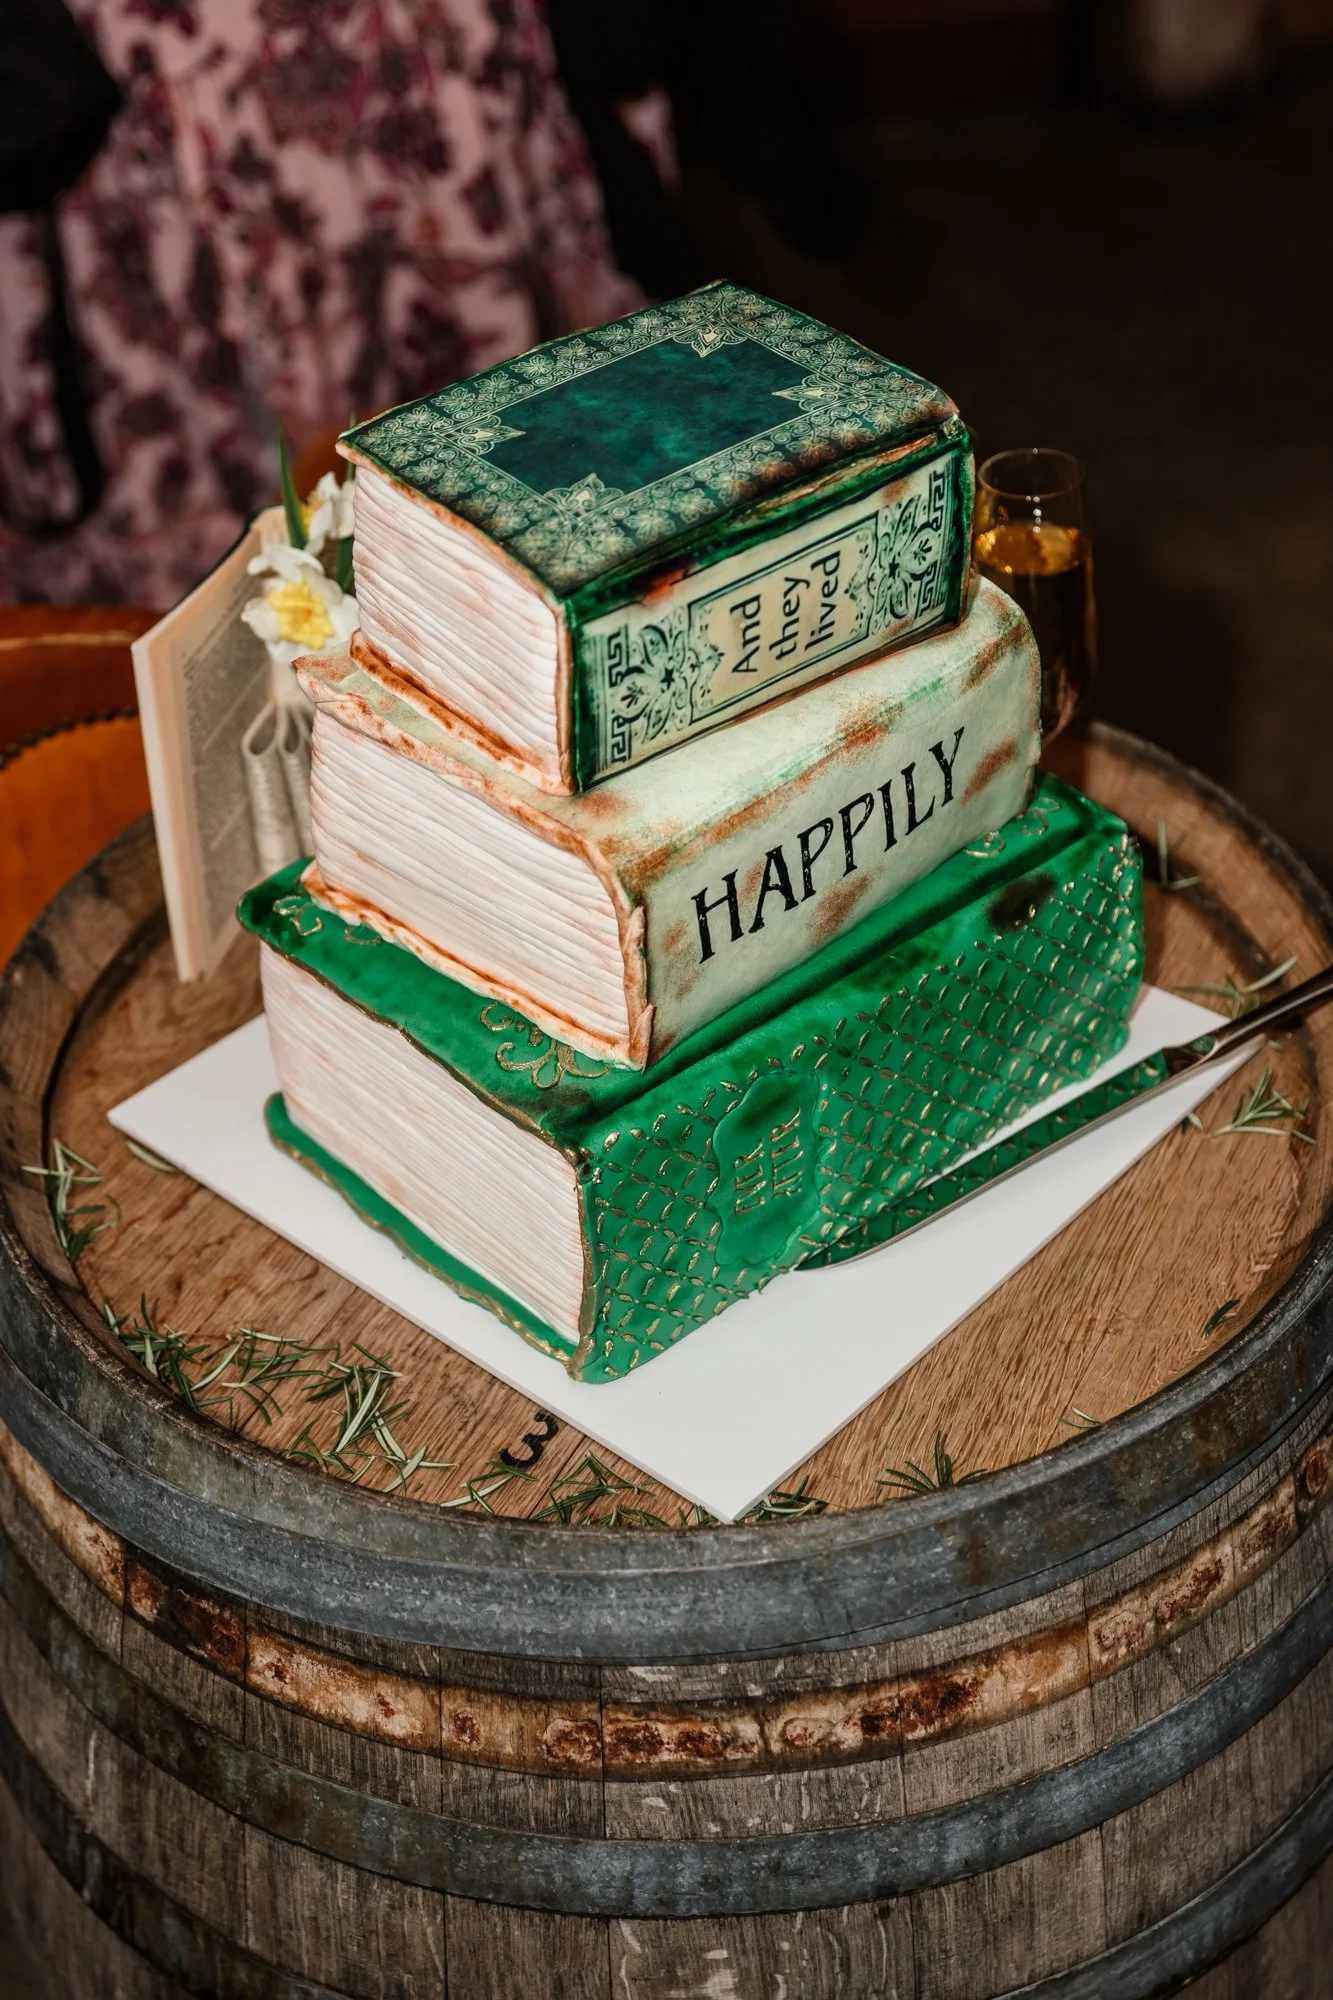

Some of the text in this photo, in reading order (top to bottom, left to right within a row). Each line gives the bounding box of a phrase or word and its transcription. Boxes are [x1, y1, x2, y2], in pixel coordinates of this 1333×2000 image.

[729, 593, 762, 674] And
[768, 576, 811, 660] they
[804, 550, 842, 651] lived
[691, 726, 965, 965] HAPPILY
[734, 1137, 768, 1216] EVER
[770, 1106, 804, 1200] AFTER
[499, 1409, 559, 1468] 3
